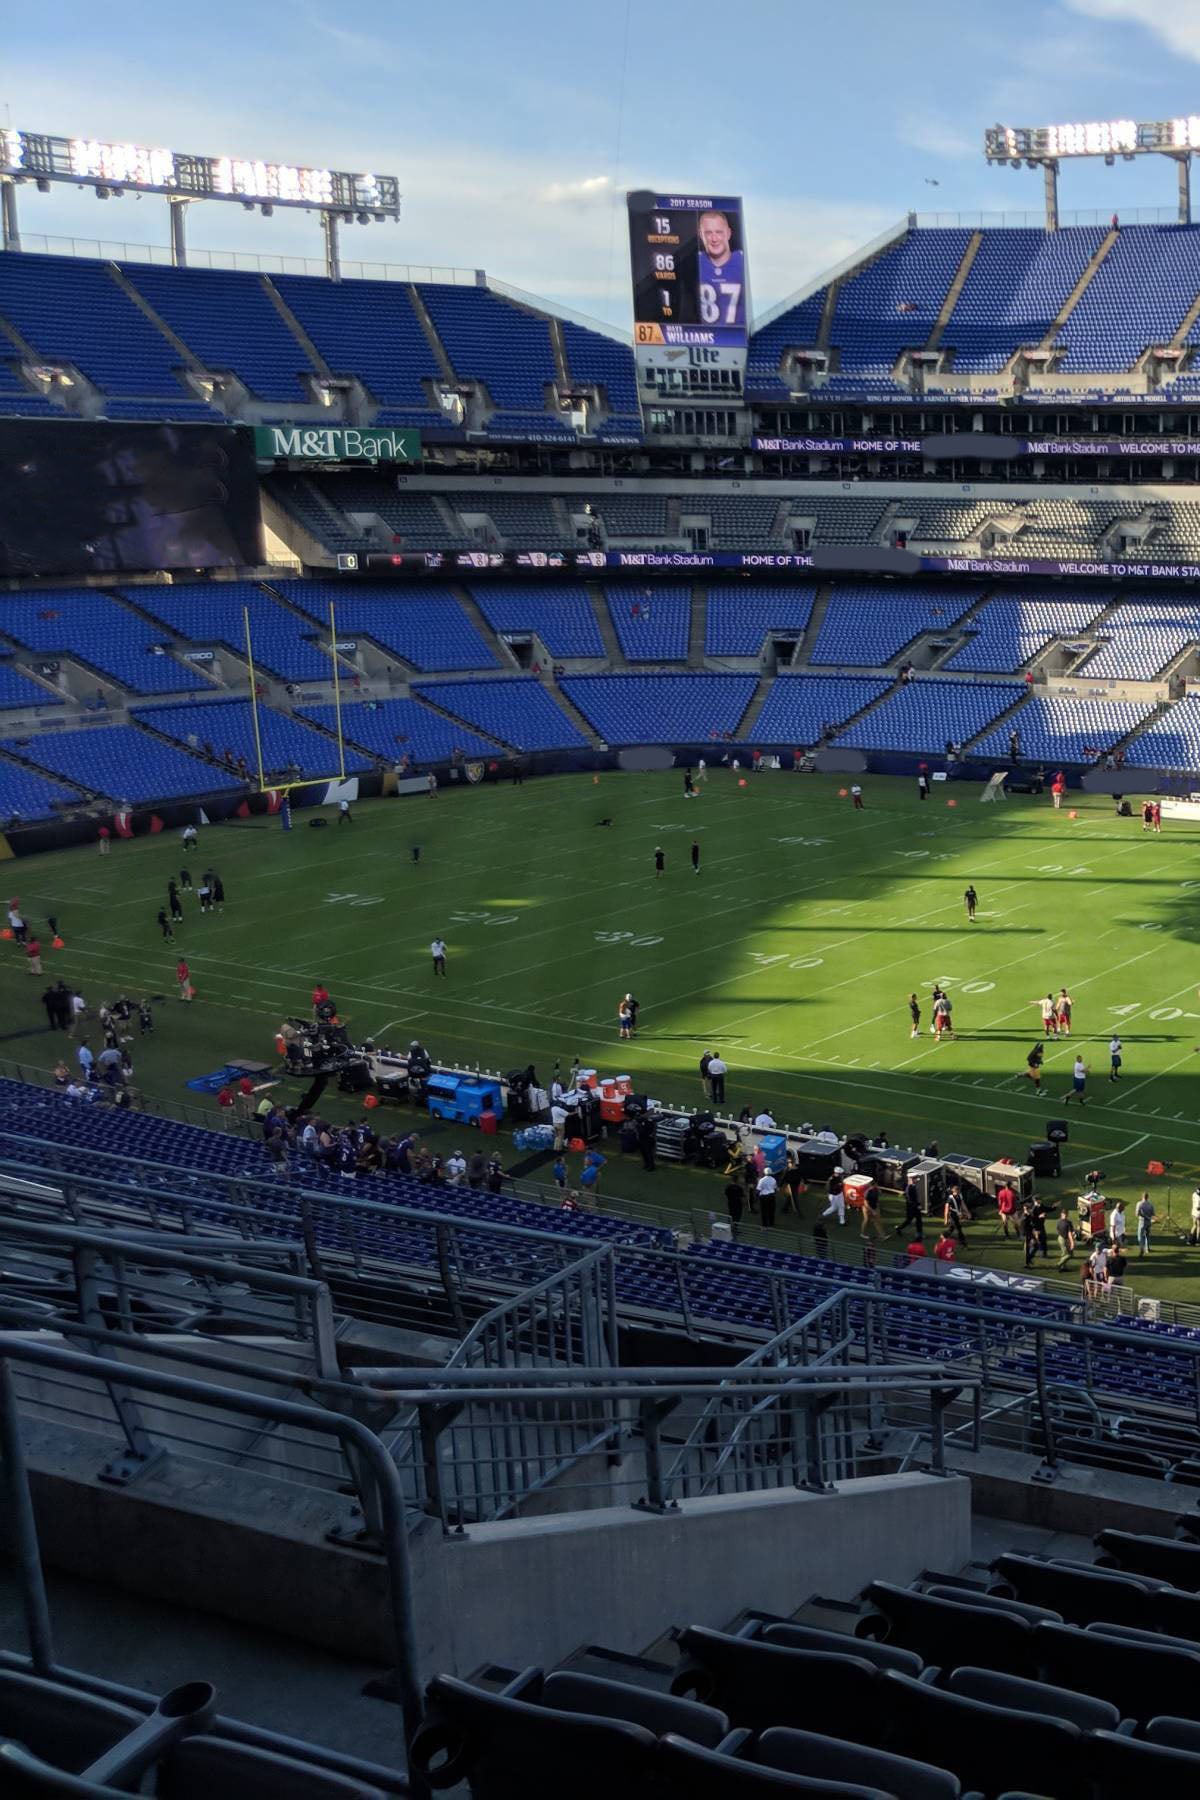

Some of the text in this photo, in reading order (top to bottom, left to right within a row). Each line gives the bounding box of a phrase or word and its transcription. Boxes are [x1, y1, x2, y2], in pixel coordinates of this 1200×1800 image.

[670, 199, 713, 209] 2017 SEASON
[655, 218, 671, 234] 15
[655, 254, 674, 271] 86
[655, 271, 677, 281] YARDS
[662, 290, 671, 307] 1
[700, 283, 742, 324] 87
[638, 325, 654, 342] 87
[667, 332, 715, 344] WILLIAMS
[687, 347, 720, 367] Lite
[272, 428, 408, 458] M&T Bank
[757, 439, 844, 452] M&T Bank Stadium
[853, 440, 921, 452] HOME OF THE
[1028, 442, 1109, 454] M&T Bank Stadium
[1119, 443, 1170, 454] WELCOME
[1172, 443, 1186, 454] TO
[620, 554, 714, 566] M&T Bank Stadium
[742, 555, 815, 567] HOME OF THE
[947, 559, 1030, 573] M&T Bank Stadium
[1059, 562, 1109, 575] WELCOME
[1112, 564, 1126, 575] TO
[1127, 565, 1149, 576] M&T
[1152, 565, 1179, 577] BANK
[752, 953, 823, 969] 40
[920, 976, 994, 994] 50
[1105, 1003, 1182, 1021] 40
